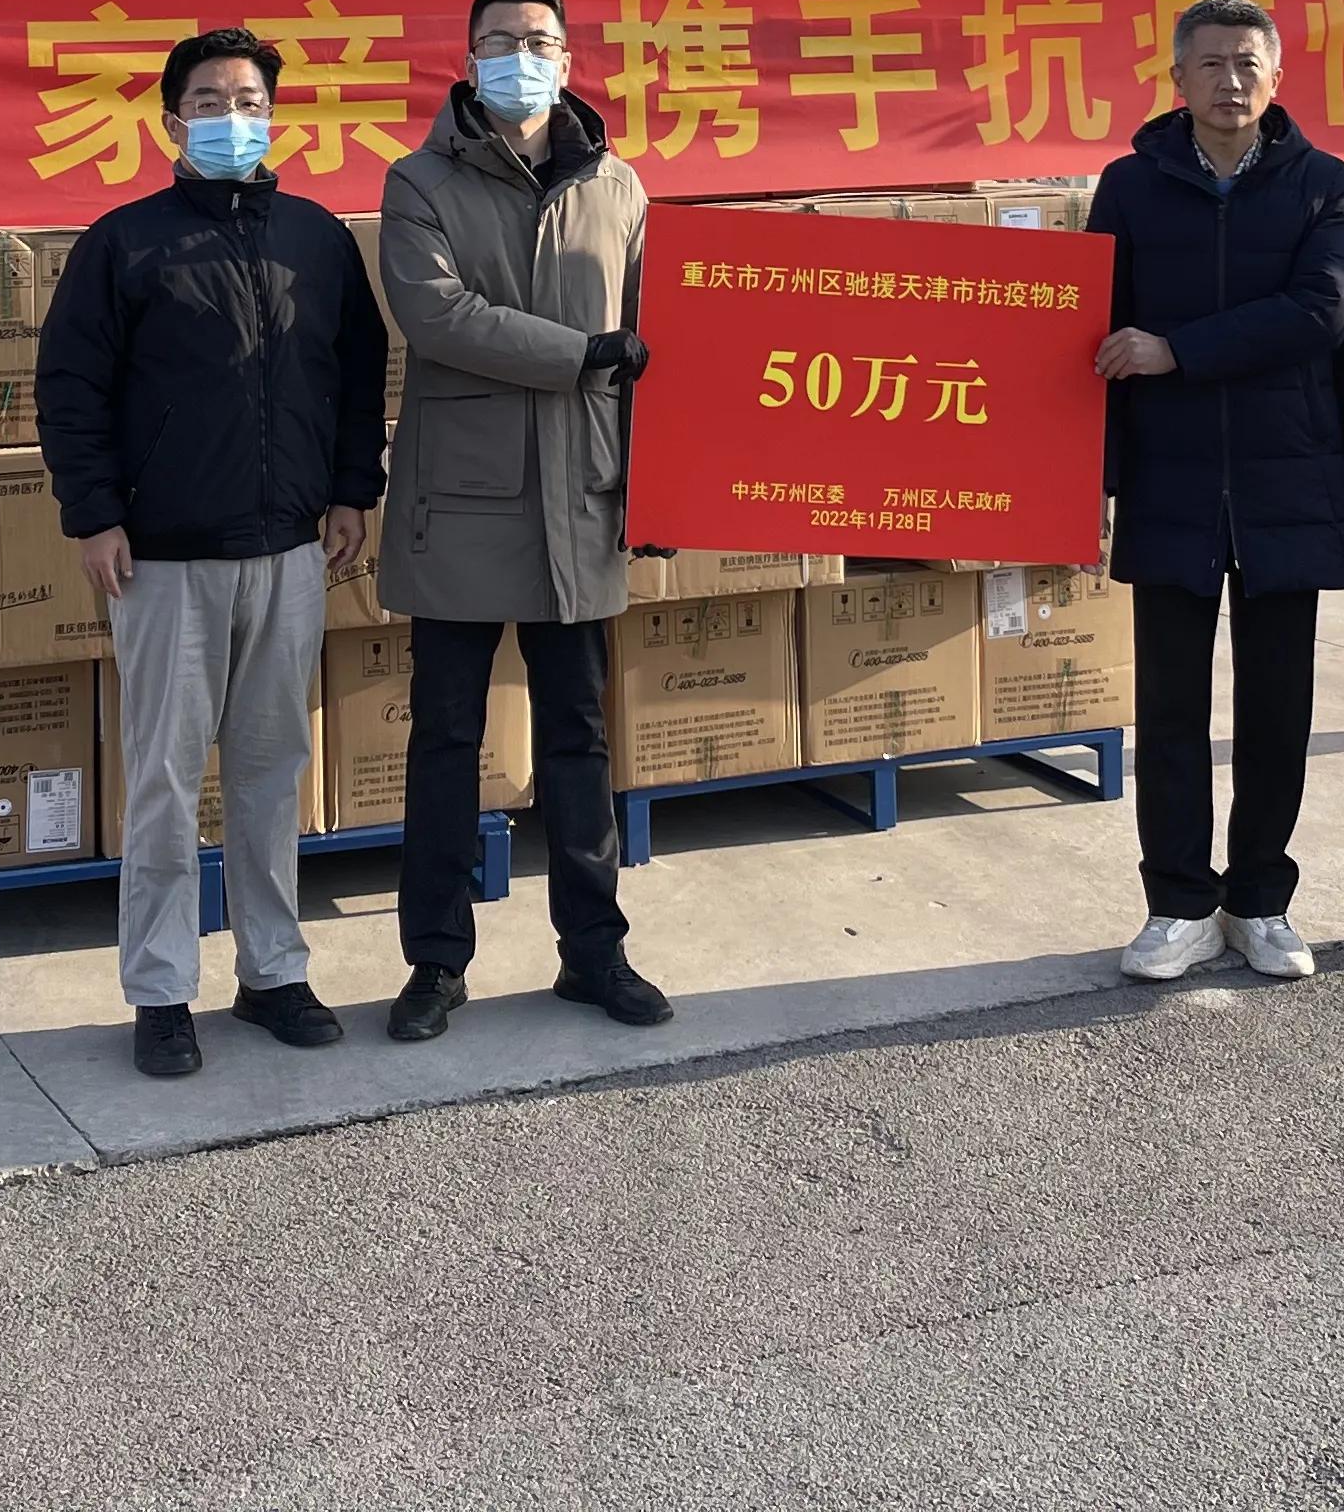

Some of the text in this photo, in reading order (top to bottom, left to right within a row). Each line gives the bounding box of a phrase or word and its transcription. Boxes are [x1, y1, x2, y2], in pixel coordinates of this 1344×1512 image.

[681, 260, 1080, 311] 重庆市万州区驰援天津市抗疫物资
[758, 350, 989, 425] 50万元
[731, 481, 1013, 513] 中共万州区委 万州区人民政府
[810, 509, 933, 532] 2022年1月28日
